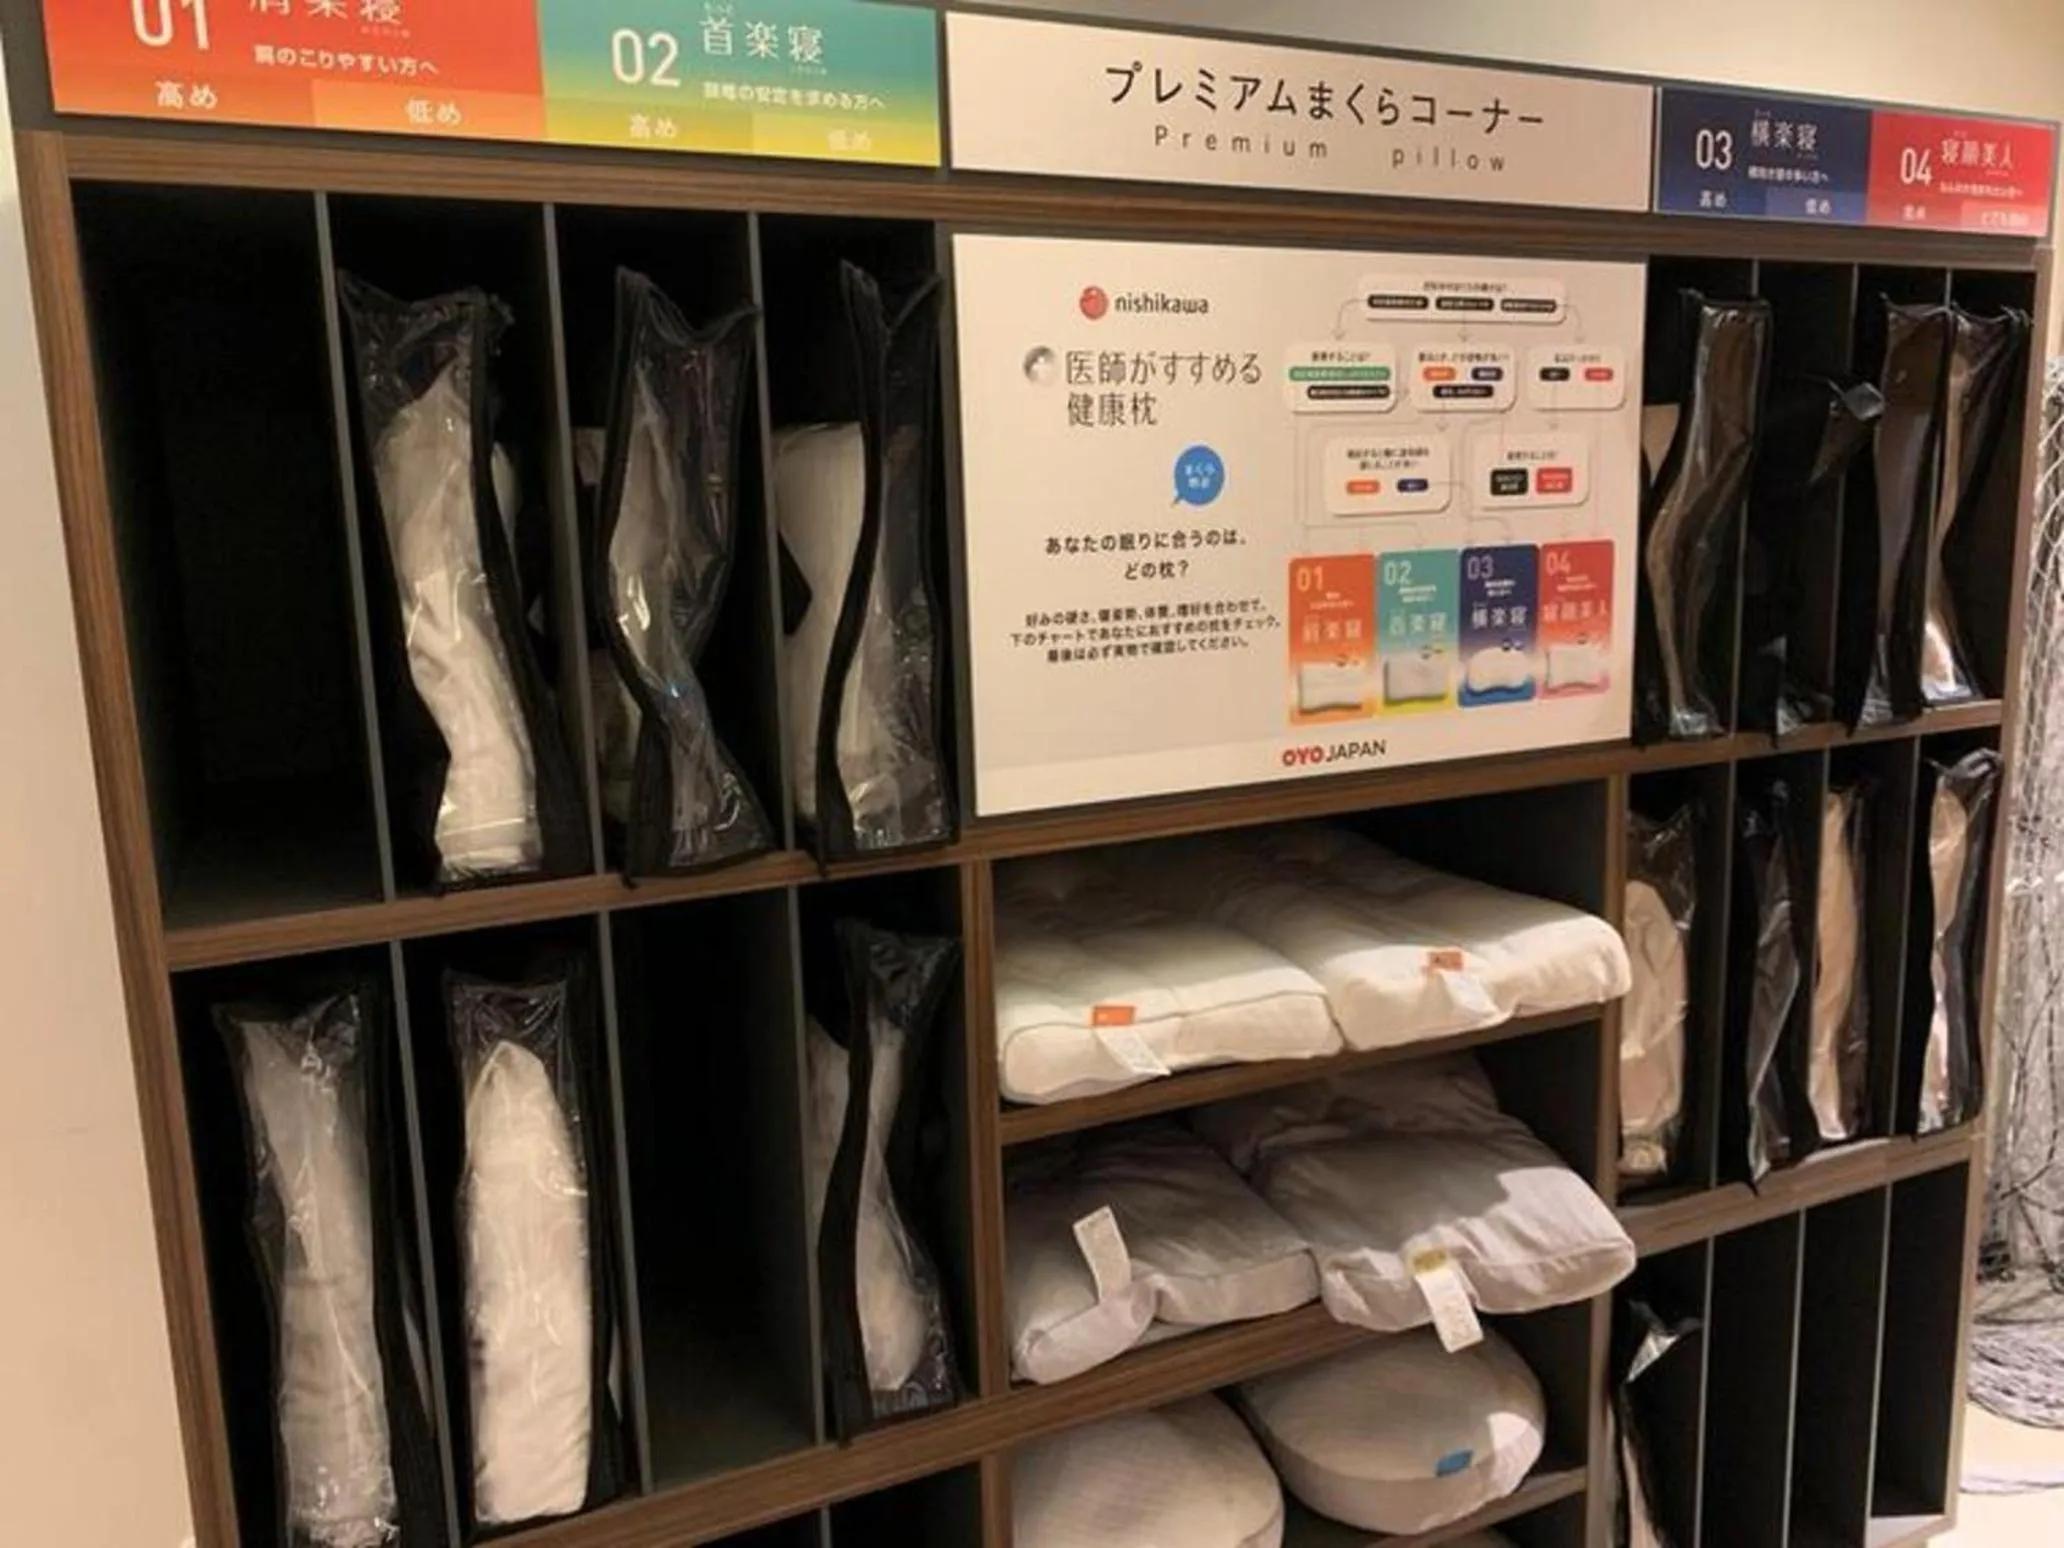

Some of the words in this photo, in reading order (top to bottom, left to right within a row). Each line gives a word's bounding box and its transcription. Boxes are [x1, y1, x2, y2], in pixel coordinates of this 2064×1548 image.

[131, 0, 209, 49] 01
[700, 16, 824, 64] 首楽寝
[253, 44, 439, 77] 肩のこりやすい方へ
[611, 27, 682, 88] 02
[154, 79, 218, 110] 高め
[1105, 61, 1545, 134] プレミアムまくらコーナー
[405, 98, 461, 126] 低め
[629, 113, 678, 140] 高め
[1155, 125, 1328, 158] Premium
[1392, 147, 1505, 171] pillow
[1695, 128, 1734, 170] 03
[1751, 118, 1819, 151] 横楽寝
[1900, 146, 1933, 187] 04
[1700, 189, 1728, 209] 高め
[1114, 292, 1209, 314] nishikawa
[1066, 350, 1262, 385] 医師がすすめる
[1067, 391, 1159, 428] 健康枕
[1296, 566, 1325, 593] 01
[1384, 561, 1412, 586] 02
[1466, 555, 1494, 581] 03
[1545, 551, 1572, 577] 04
